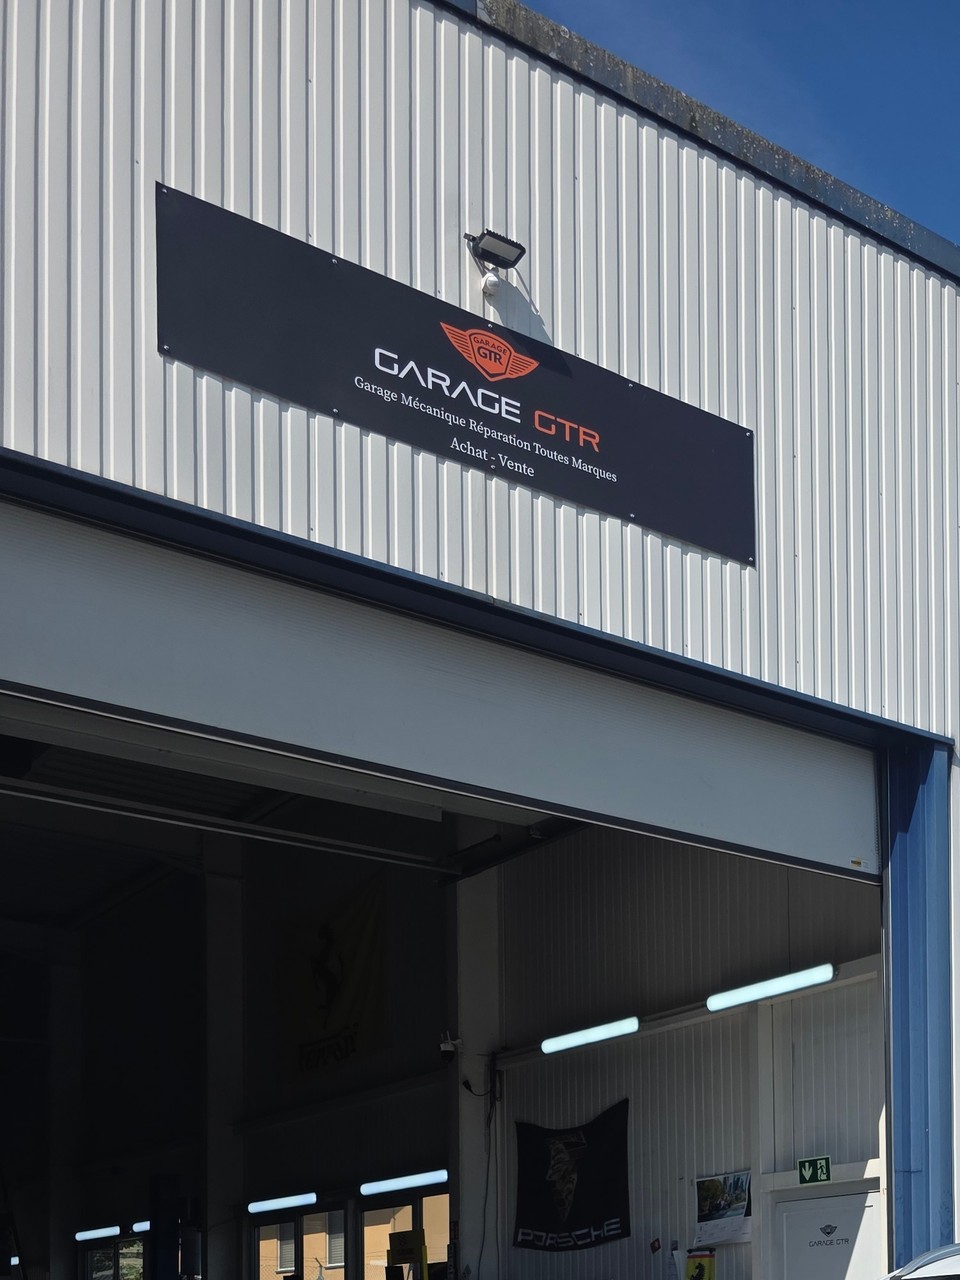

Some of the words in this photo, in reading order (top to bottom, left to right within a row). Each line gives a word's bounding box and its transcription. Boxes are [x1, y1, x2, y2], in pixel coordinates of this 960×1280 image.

[473, 336, 508, 356] GARAGE
[477, 346, 503, 366] GTR
[374, 347, 522, 424] GARAGE
[533, 409, 600, 452] GTR
[354, 376, 398, 402] Garage
[400, 392, 466, 427] Mécanique
[469, 418, 531, 451] Réparation
[533, 442, 569, 465] Toutes
[571, 458, 618, 483] Marques
[450, 437, 489, 461] Achat
[498, 453, 535, 477] Vente
[517, 1218, 622, 1248] PORSCHE
[808, 1239, 835, 1248] GARAGE
[835, 1238, 850, 1246] GTR
